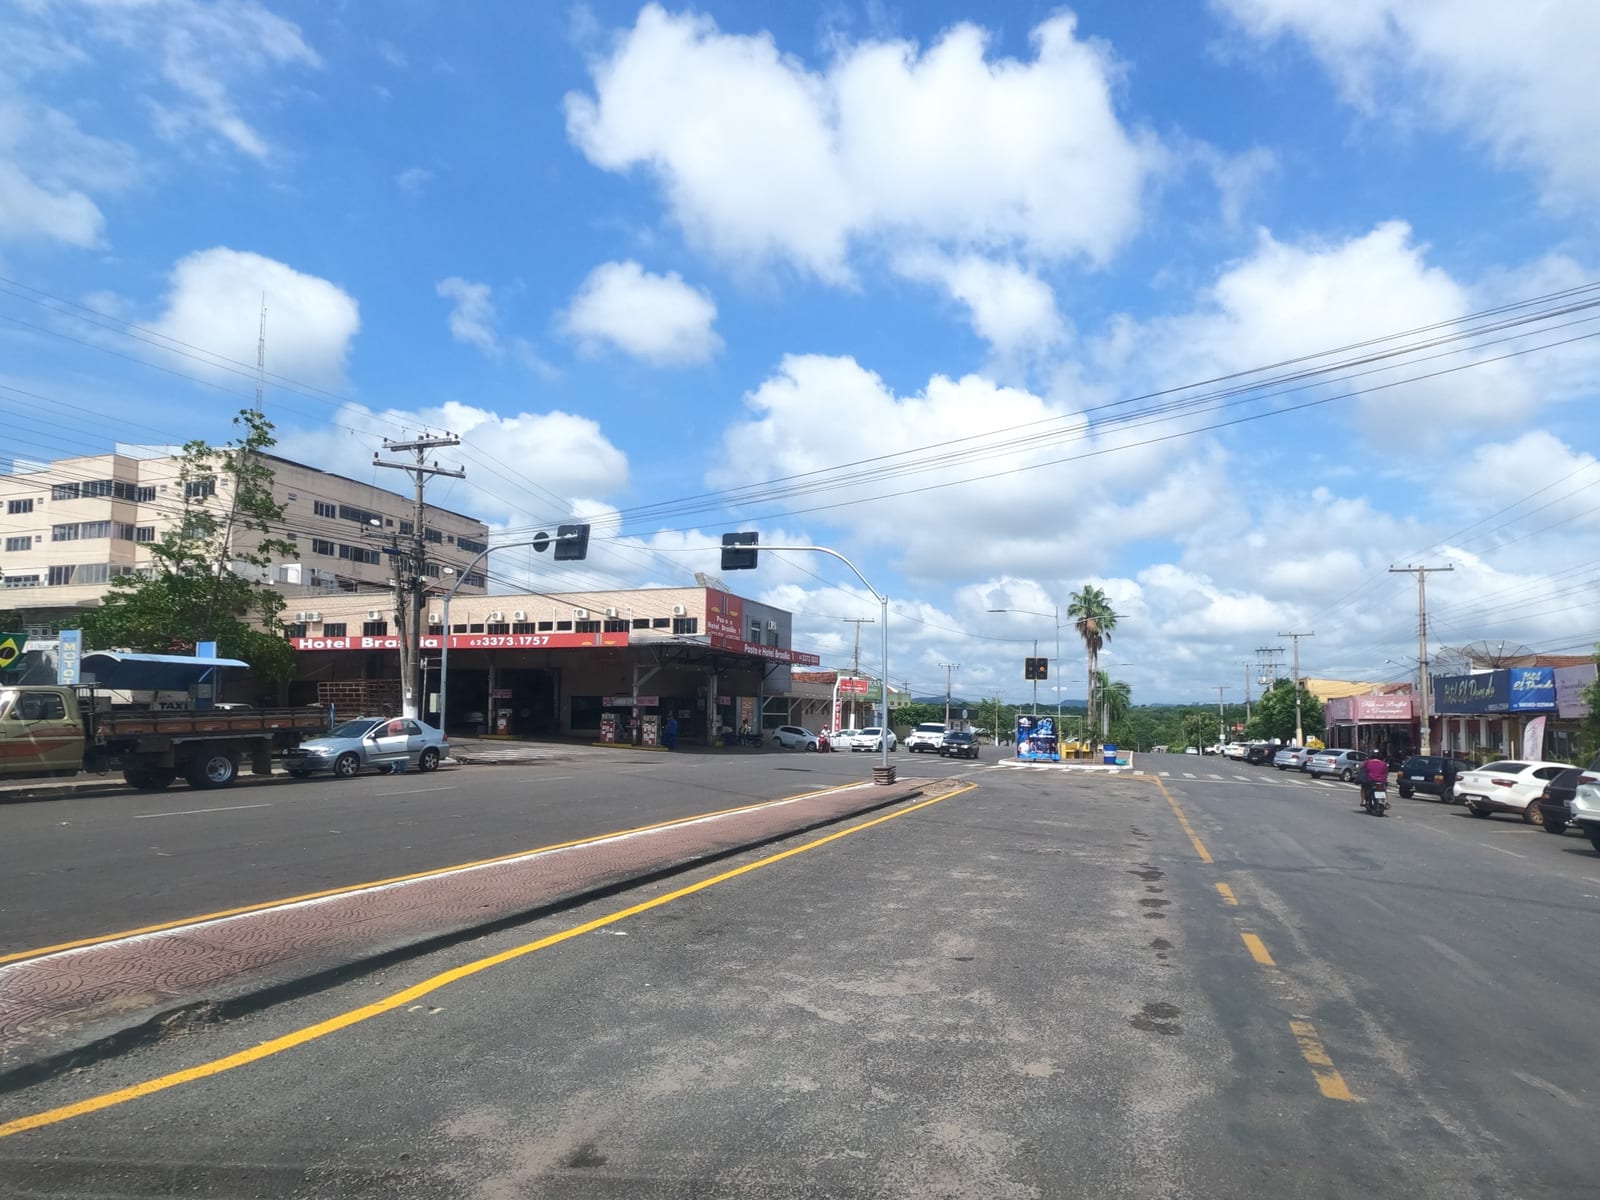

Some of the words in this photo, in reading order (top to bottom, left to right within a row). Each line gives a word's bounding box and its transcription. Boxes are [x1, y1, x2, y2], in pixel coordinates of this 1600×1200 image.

[299, 637, 351, 650] Hotel
[453, 638, 457, 647] 1
[158, 702, 188, 710] TAXI
